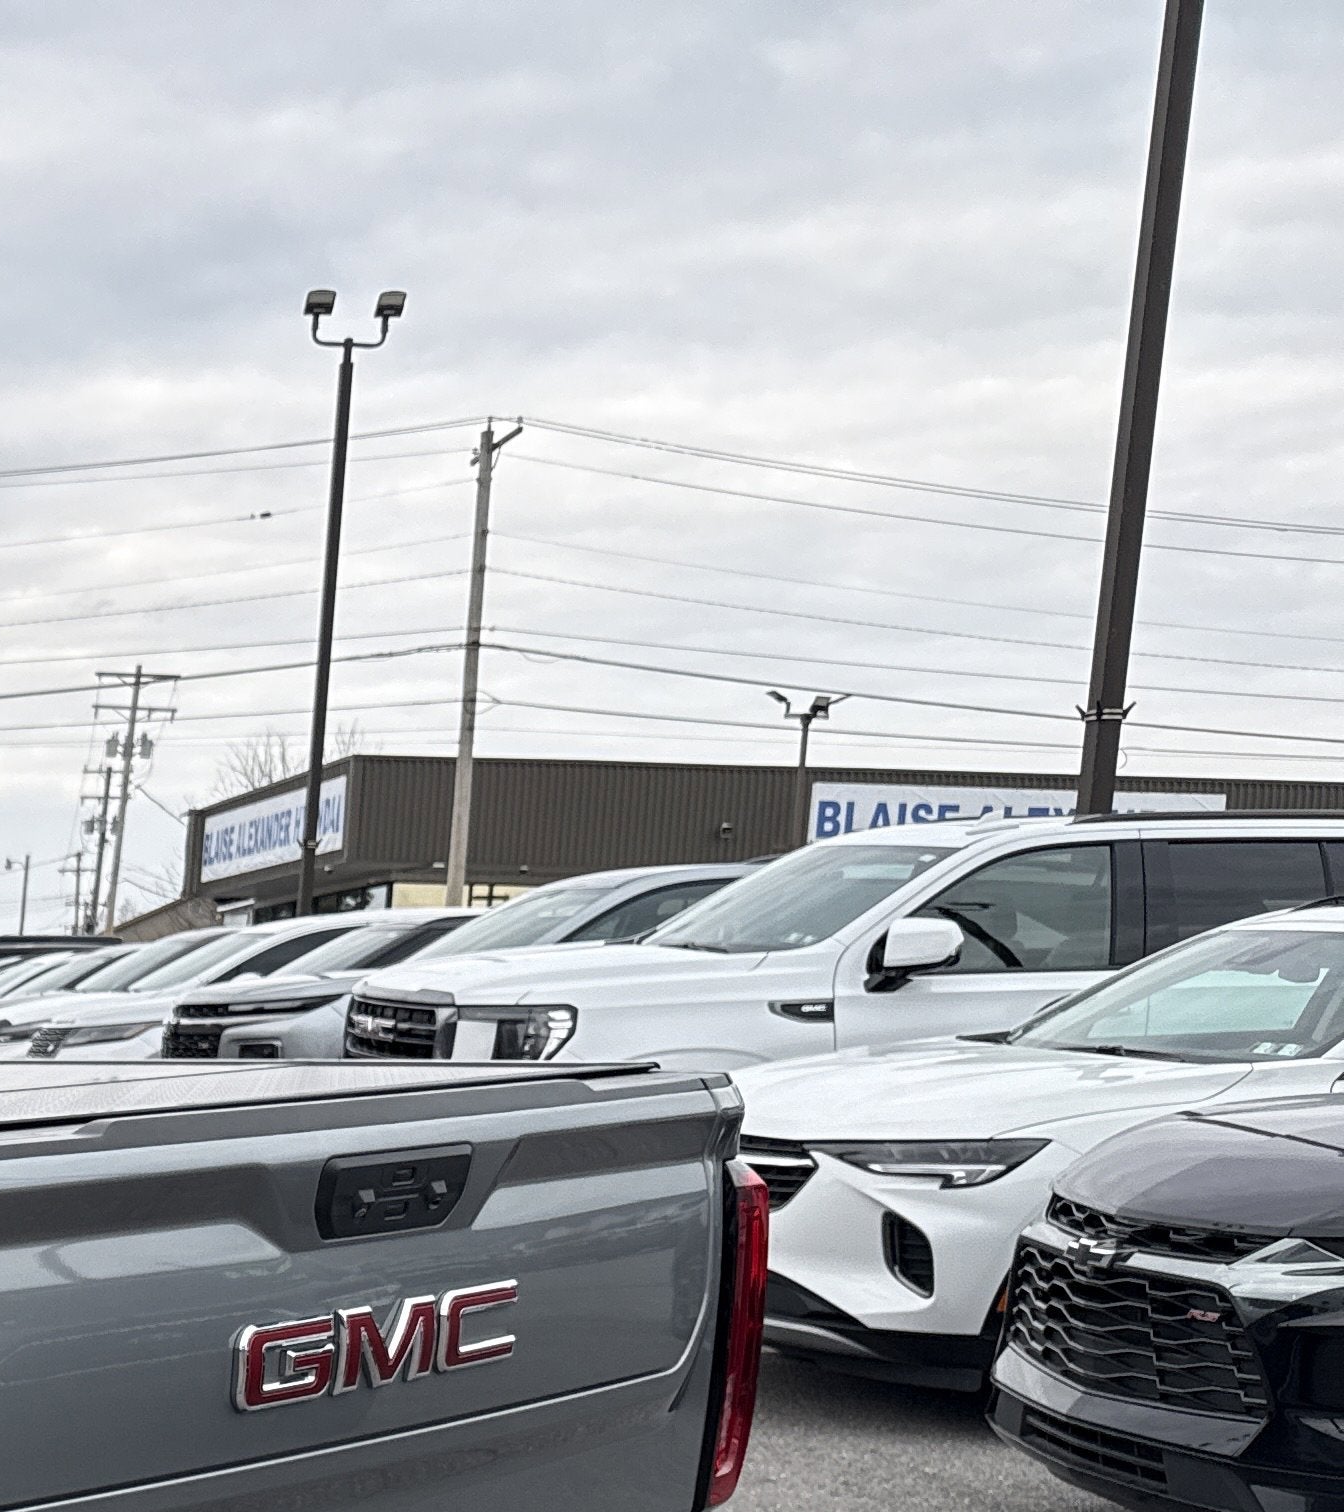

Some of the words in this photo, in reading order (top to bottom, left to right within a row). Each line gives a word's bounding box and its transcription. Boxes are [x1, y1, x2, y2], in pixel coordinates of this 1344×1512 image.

[202, 825, 235, 866] BLAISE
[234, 808, 292, 858] ALEXANDER
[230, 1278, 519, 1412] GMC
